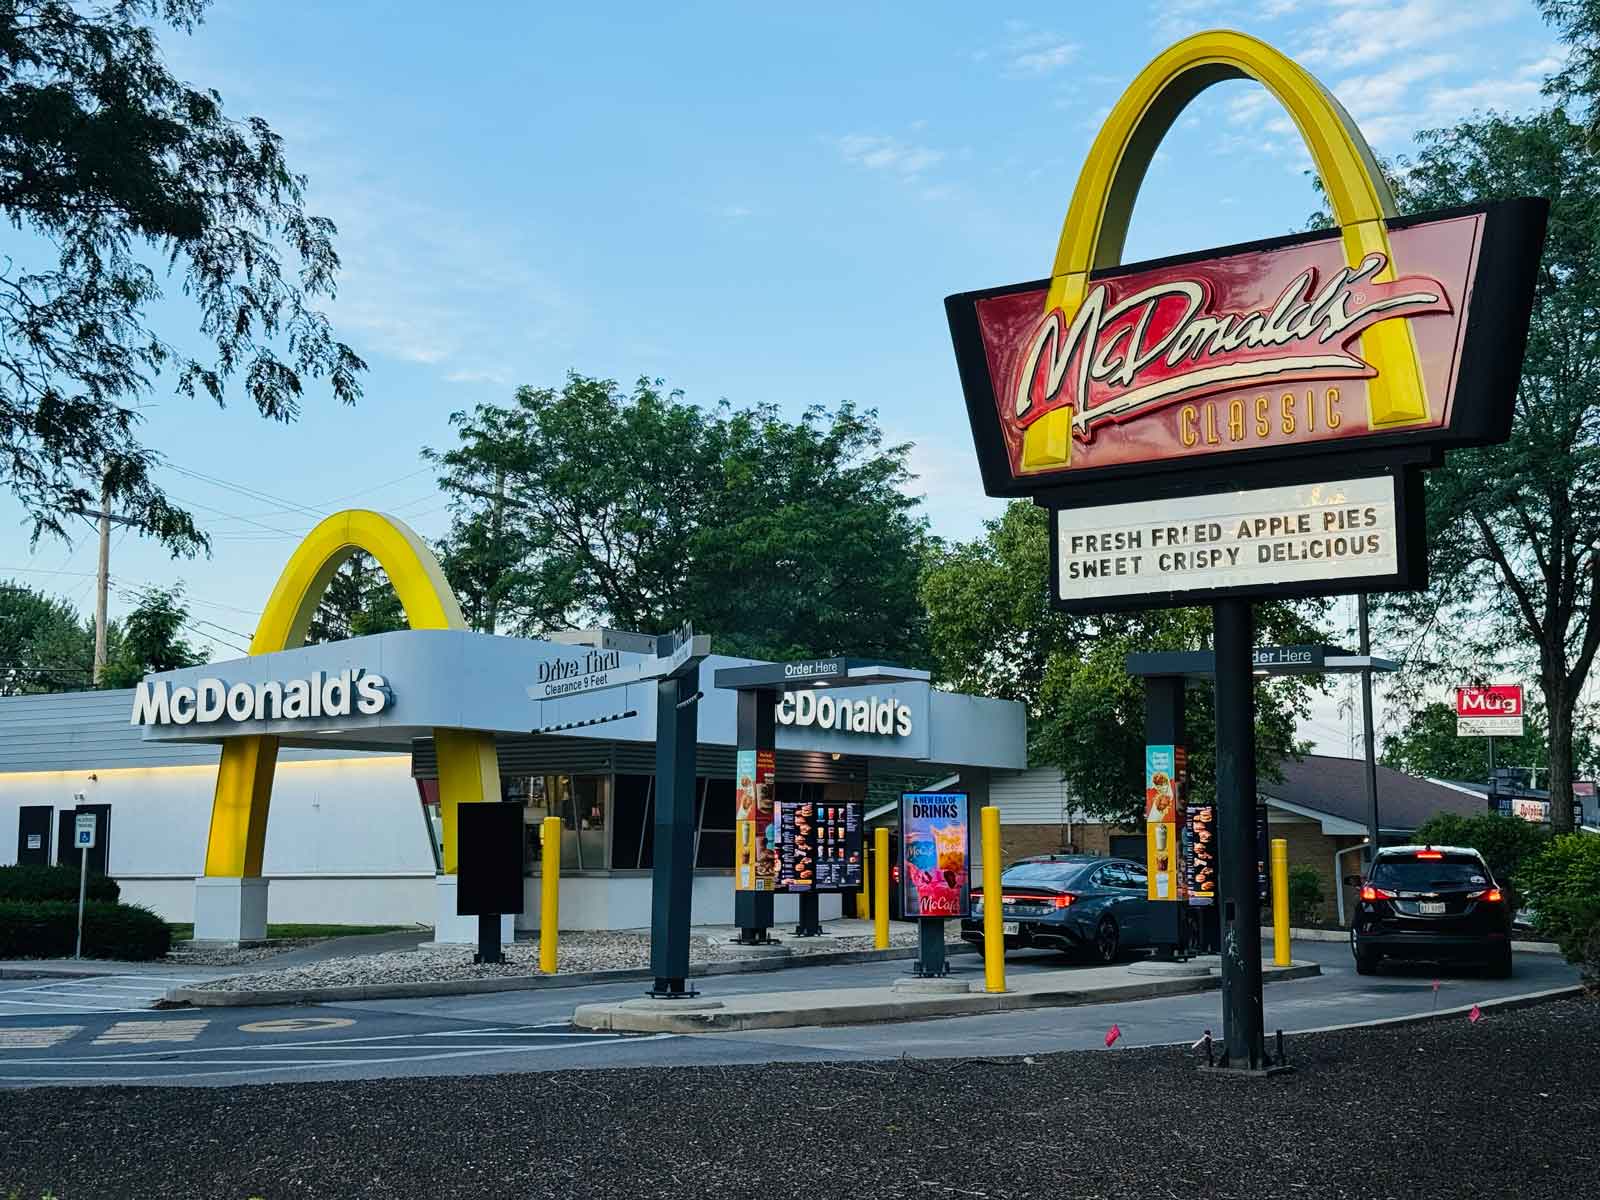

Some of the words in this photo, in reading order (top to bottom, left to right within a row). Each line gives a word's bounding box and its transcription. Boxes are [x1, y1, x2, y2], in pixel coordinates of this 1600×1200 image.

[1016, 254, 1438, 428] McDonald's
[1180, 388, 1342, 447] CLASSIC
[1071, 530, 1142, 554] FRESH
[1152, 523, 1222, 547] FRIED
[1236, 513, 1311, 539] APPLE
[1323, 507, 1377, 531] PIES
[1069, 555, 1143, 580] SWEET
[1158, 547, 1241, 572] CRISPY
[1258, 534, 1380, 563] DELICIOUS
[539, 657, 579, 684] Drive
[582, 650, 620, 674] Thru
[785, 664, 814, 675] Order
[815, 661, 838, 672] Here
[1252, 650, 1275, 663] der
[1280, 649, 1312, 661] Here
[130, 668, 386, 726] McDonald's
[545, 680, 582, 695] Clearance
[584, 676, 588, 688] 9
[590, 673, 608, 686] Feet
[1462, 694, 1517, 713] Mug
[775, 689, 912, 737] cDonald's
[913, 804, 958, 818] DRINKS
